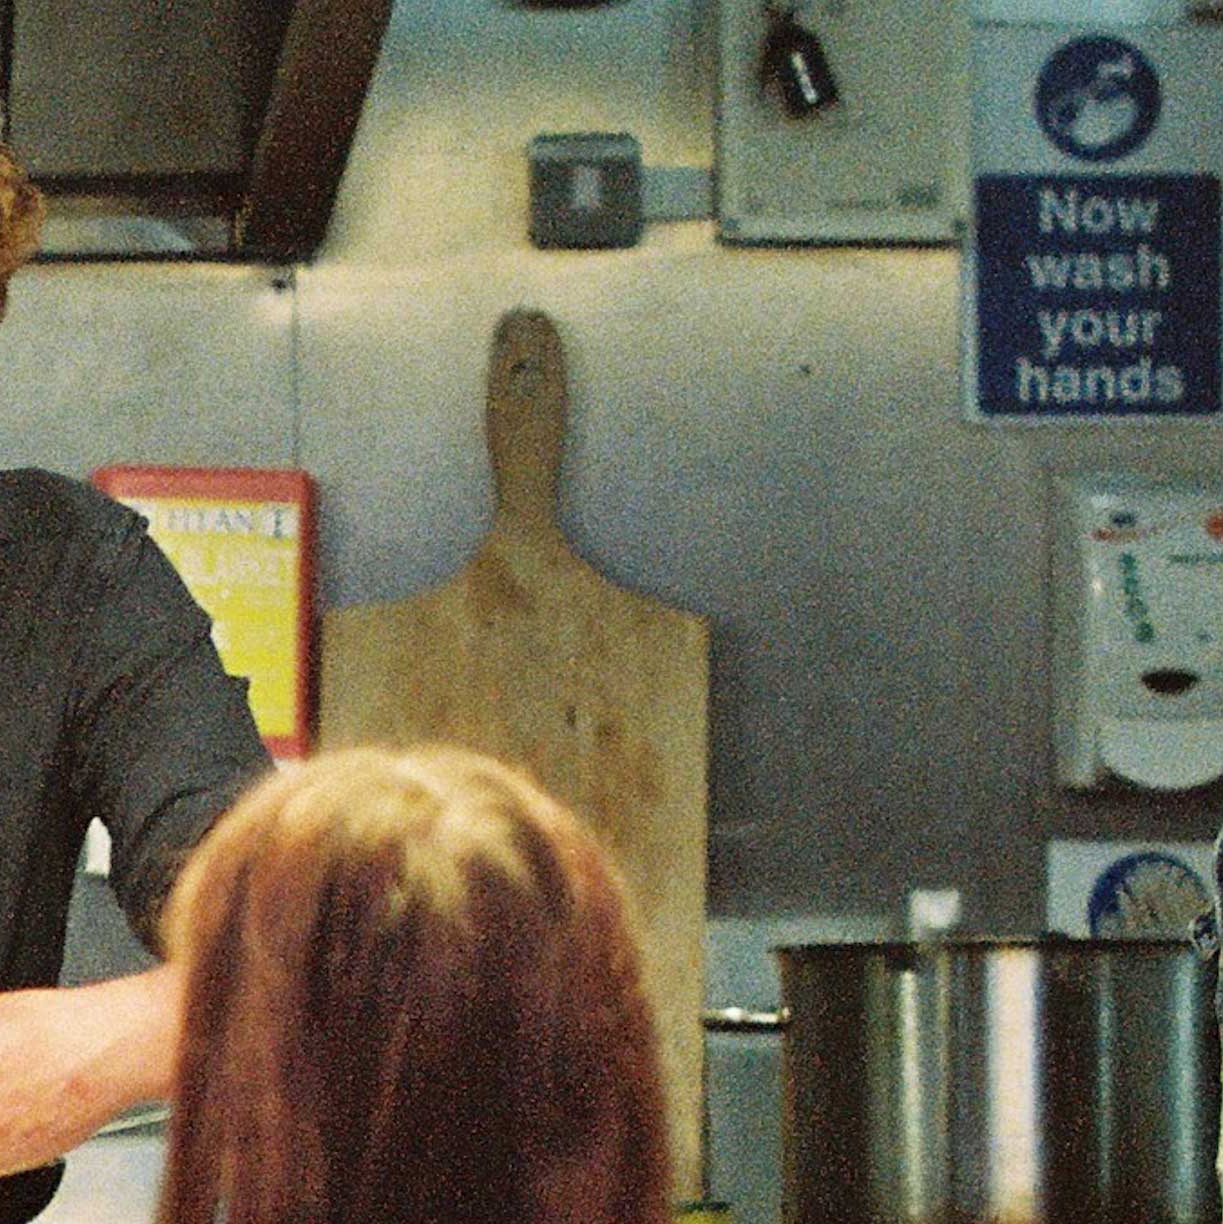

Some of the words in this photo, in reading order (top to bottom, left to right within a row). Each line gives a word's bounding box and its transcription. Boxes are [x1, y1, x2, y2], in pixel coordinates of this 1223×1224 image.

[1038, 187, 1160, 234] Now
[1025, 243, 1172, 290] wash
[1038, 308, 1163, 360] your
[1015, 355, 1185, 402] hands
